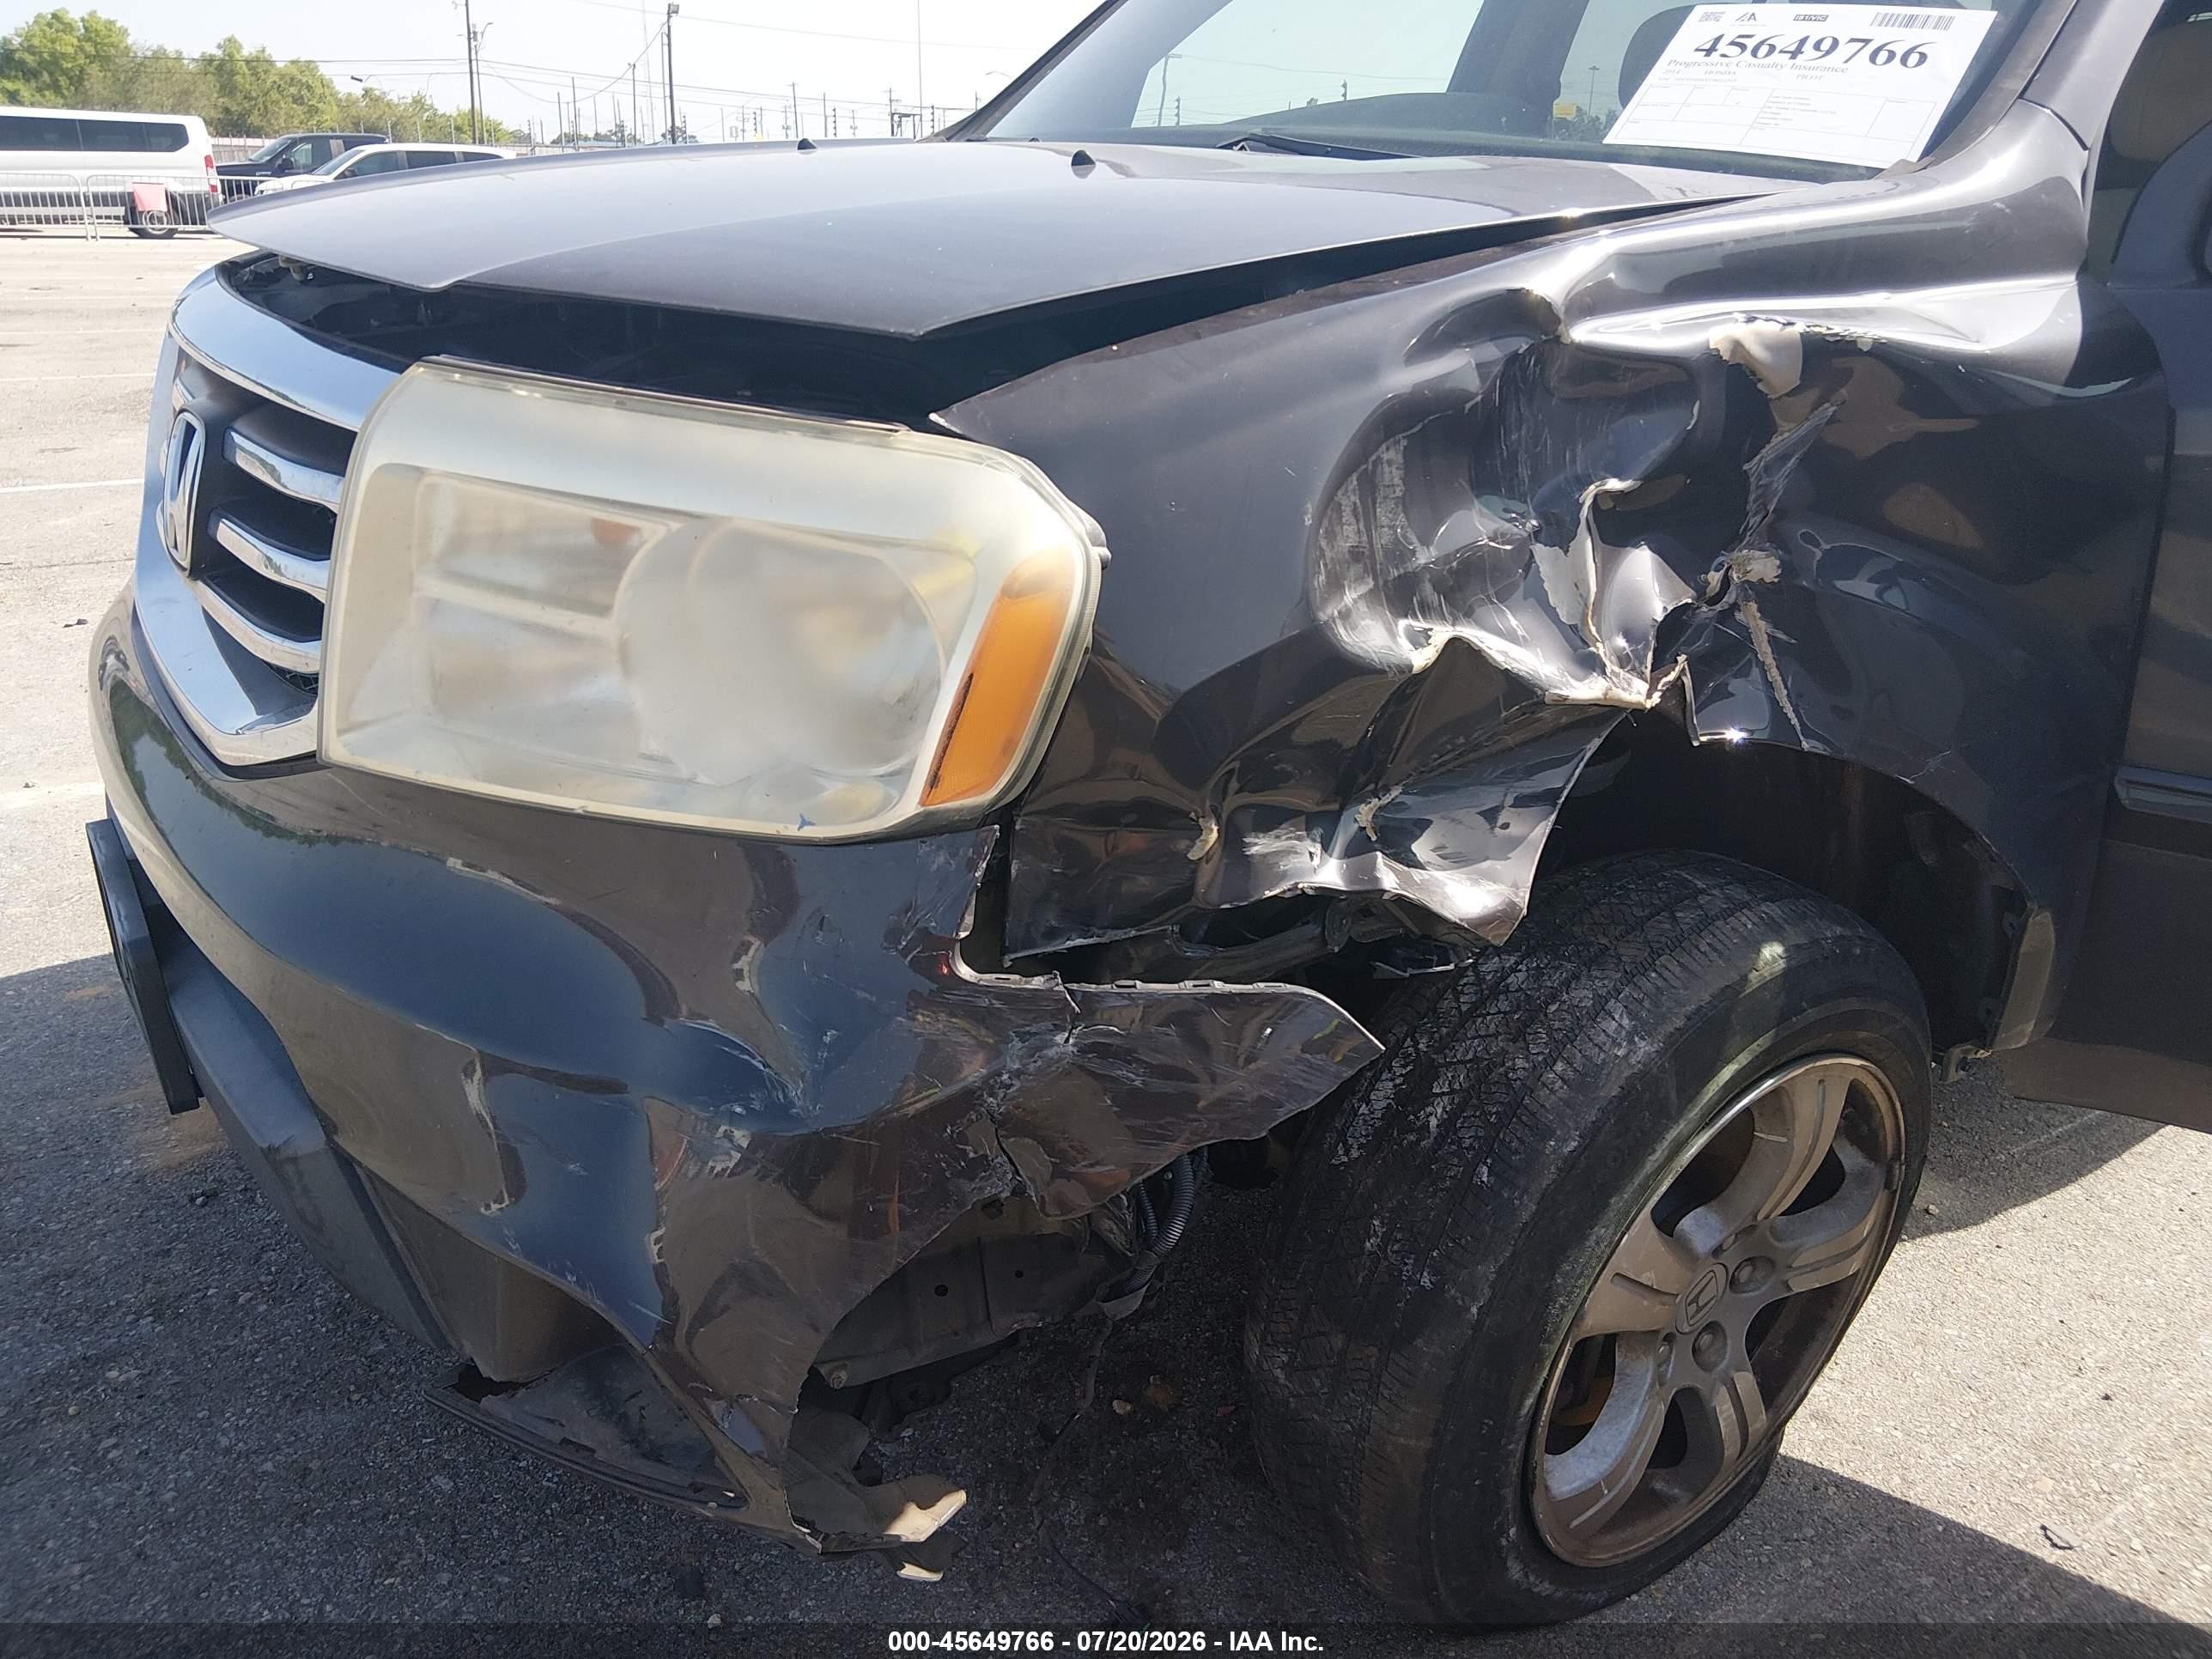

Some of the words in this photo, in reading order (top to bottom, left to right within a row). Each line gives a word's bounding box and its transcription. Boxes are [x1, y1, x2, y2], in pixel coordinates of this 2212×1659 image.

[1693, 33, 1938, 69] 45649766
[1667, 59, 1733, 69] Progressive
[1735, 60, 1786, 70] Casualty
[1790, 62, 1849, 74] Insurance
